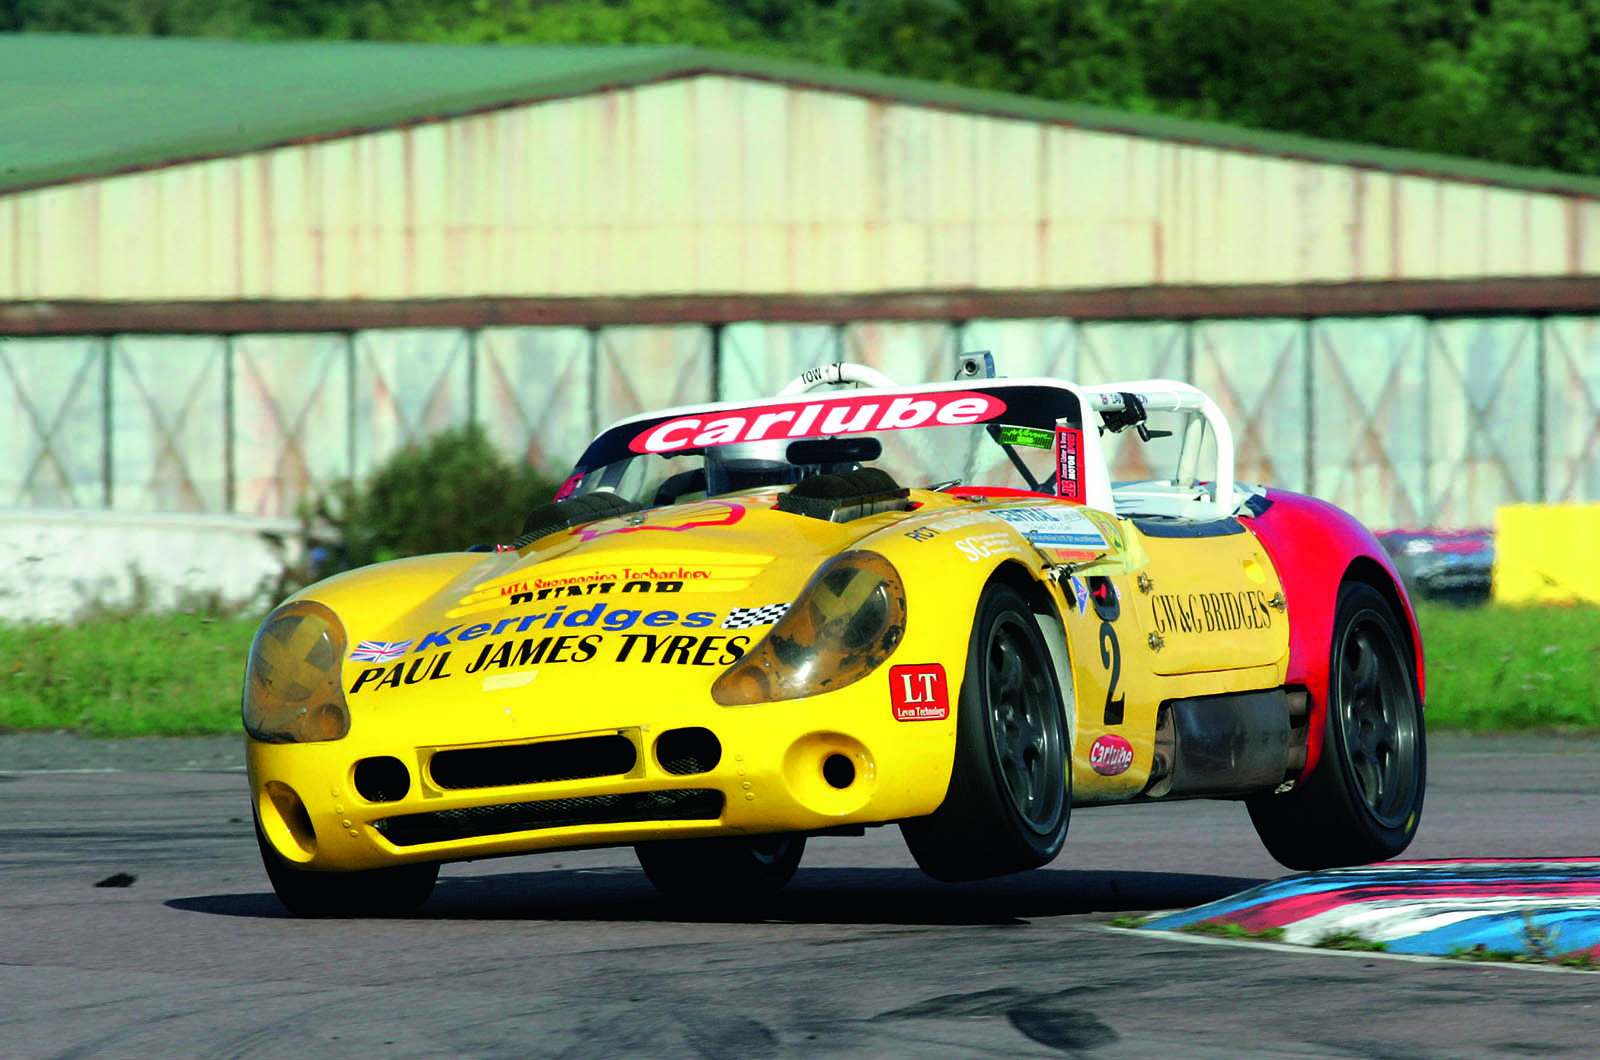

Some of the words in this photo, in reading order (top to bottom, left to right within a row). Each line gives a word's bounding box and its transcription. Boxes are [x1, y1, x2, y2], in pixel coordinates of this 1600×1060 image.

[645, 397, 989, 452] Carlube
[415, 602, 717, 653] Kerridges
[1199, 590, 1272, 632] BRIDGES
[349, 651, 452, 694] PAUL
[465, 634, 603, 674] JAMES
[615, 634, 751, 667] TYRES
[900, 673, 937, 703] LT
[1099, 621, 1125, 726] 2
